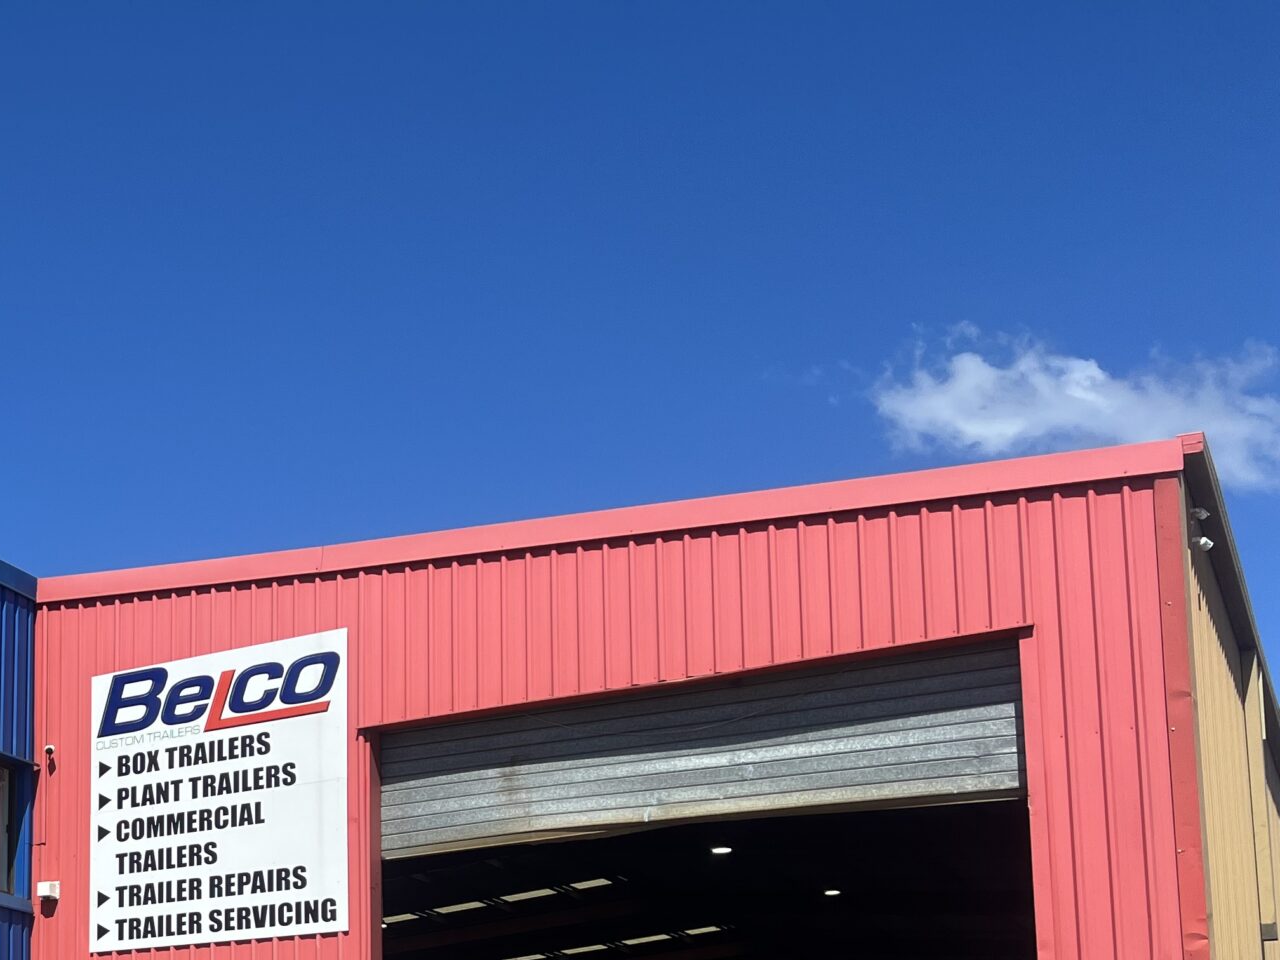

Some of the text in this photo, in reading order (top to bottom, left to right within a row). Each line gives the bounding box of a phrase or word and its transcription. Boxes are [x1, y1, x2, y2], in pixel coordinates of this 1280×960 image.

[96, 725, 200, 751] CUSTOM TRAILERS
[116, 731, 271, 778] BOX TRAILERS
[116, 762, 297, 810] PLANT TRAILERS
[115, 801, 265, 842] COMMERCIAL
[115, 841, 218, 875] TRAILERS
[115, 865, 308, 908] TRAILER REPAIRS
[115, 897, 338, 942] TRAILER SERVICING
